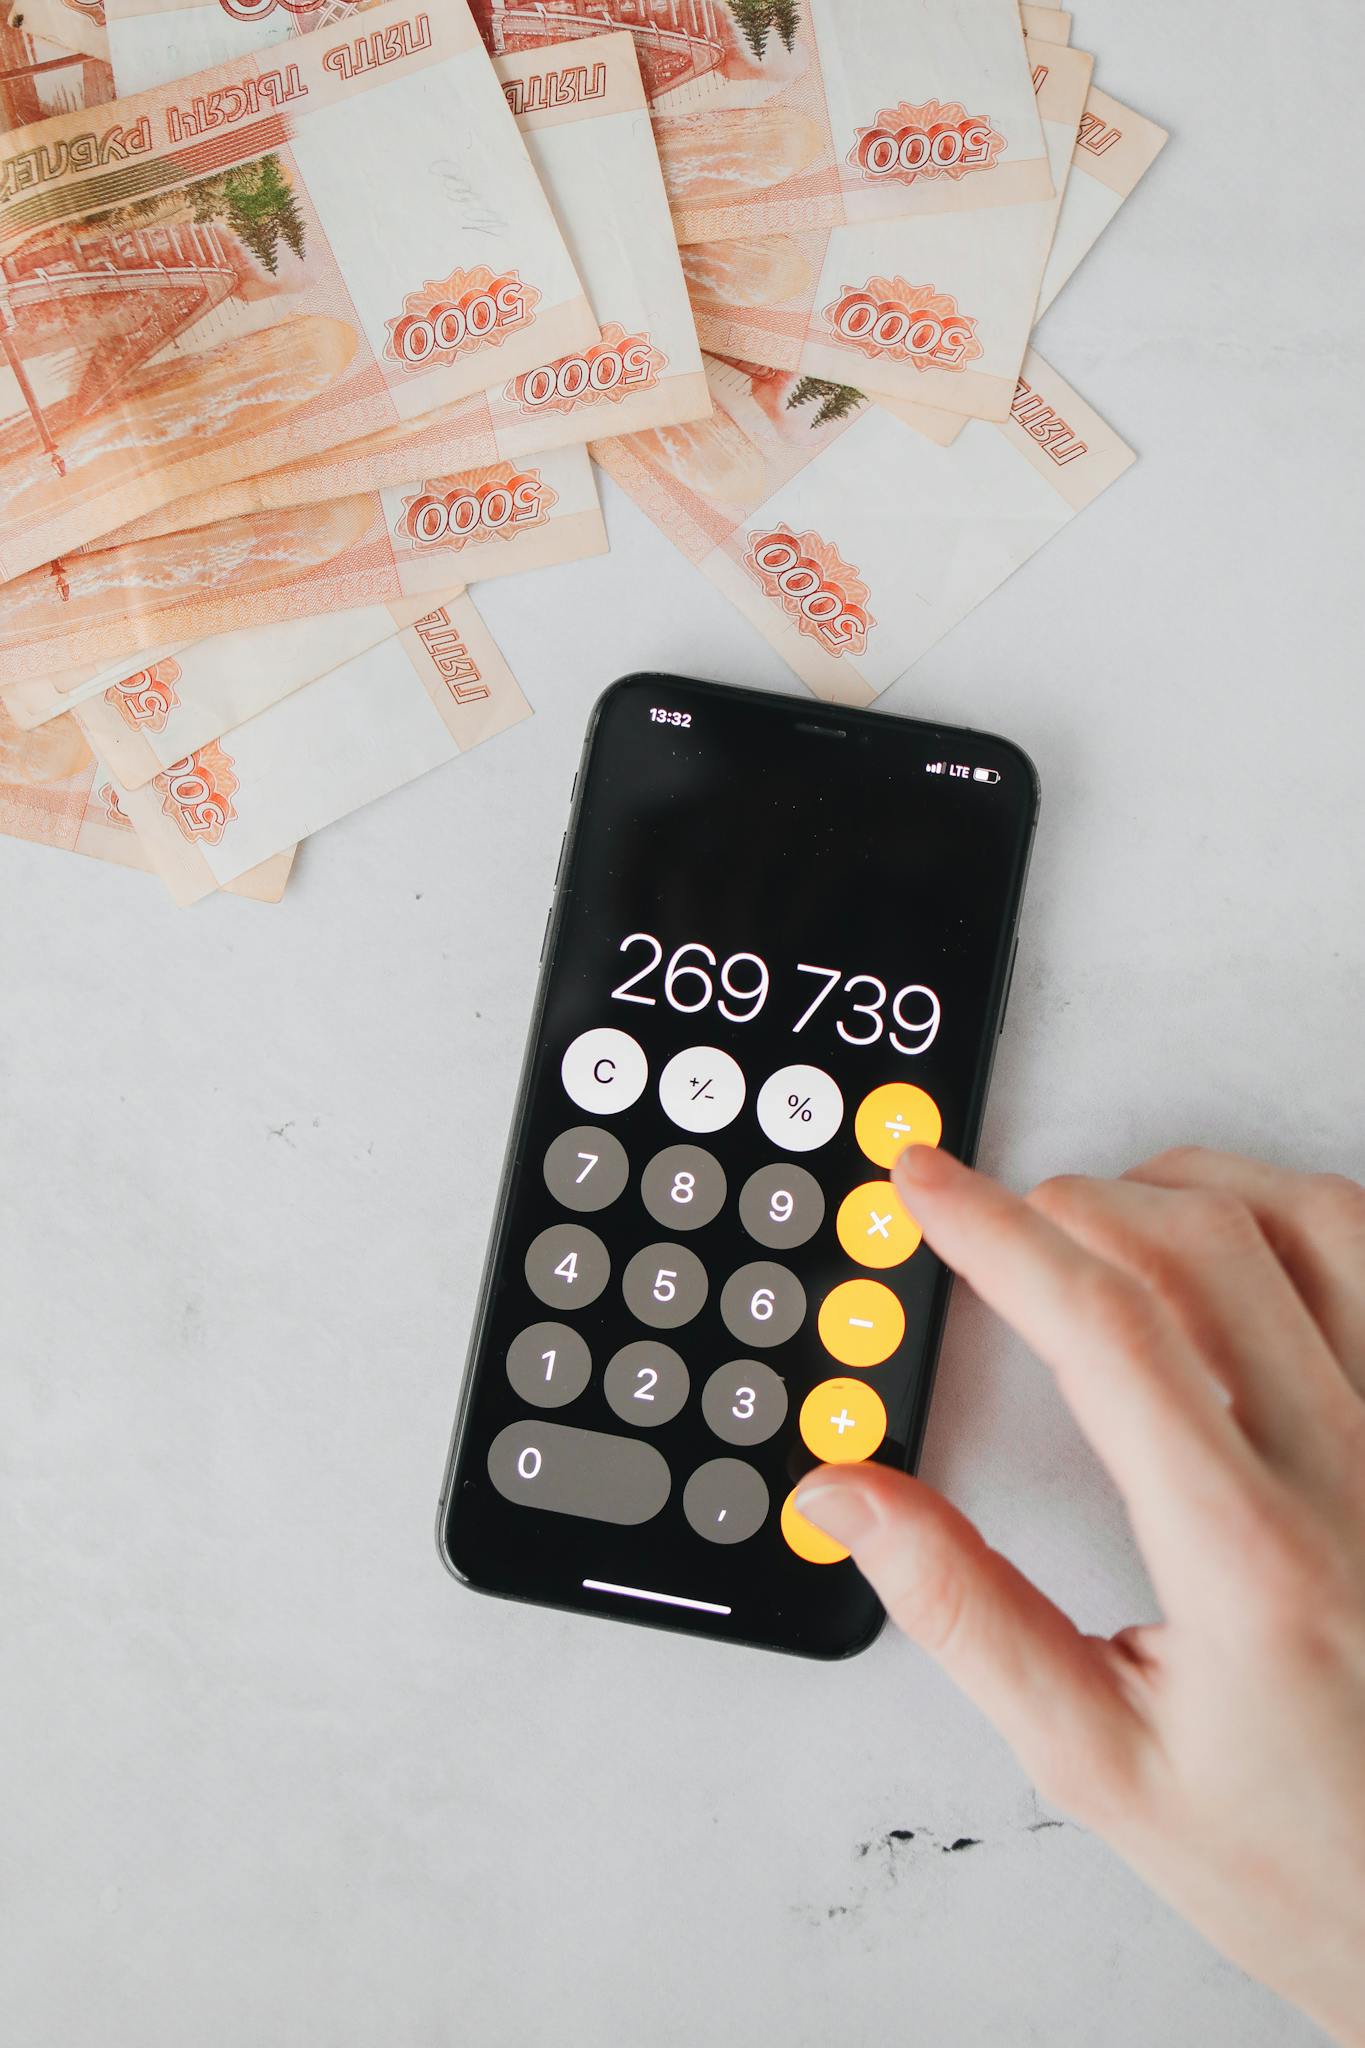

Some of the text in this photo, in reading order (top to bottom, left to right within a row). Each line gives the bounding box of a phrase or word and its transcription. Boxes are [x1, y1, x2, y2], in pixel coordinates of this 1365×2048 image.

[322, 13, 432, 80] ПЯТЬ
[166, 63, 309, 143] ТЫСЯЧ
[866, 124, 991, 173] 5000
[402, 281, 524, 362] 5000
[839, 302, 974, 363] 5000
[523, 344, 652, 406] 5000
[414, 480, 543, 542] 5000
[754, 542, 866, 645] 5000
[649, 707, 692, 729] 13:32
[949, 764, 971, 779] LTE
[611, 933, 941, 1055] 269 739
[593, 1058, 616, 1084] C
[787, 1094, 812, 1122] %
[575, 1152, 599, 1184] 7
[670, 1171, 696, 1204] 8
[769, 1190, 794, 1222] 9
[554, 1252, 578, 1284] 4
[653, 1269, 677, 1302] 5
[750, 1288, 775, 1321] 6
[540, 1350, 557, 1381] 1
[633, 1367, 658, 1401] 2
[732, 1386, 756, 1419] 3
[517, 1447, 542, 1479] 0
